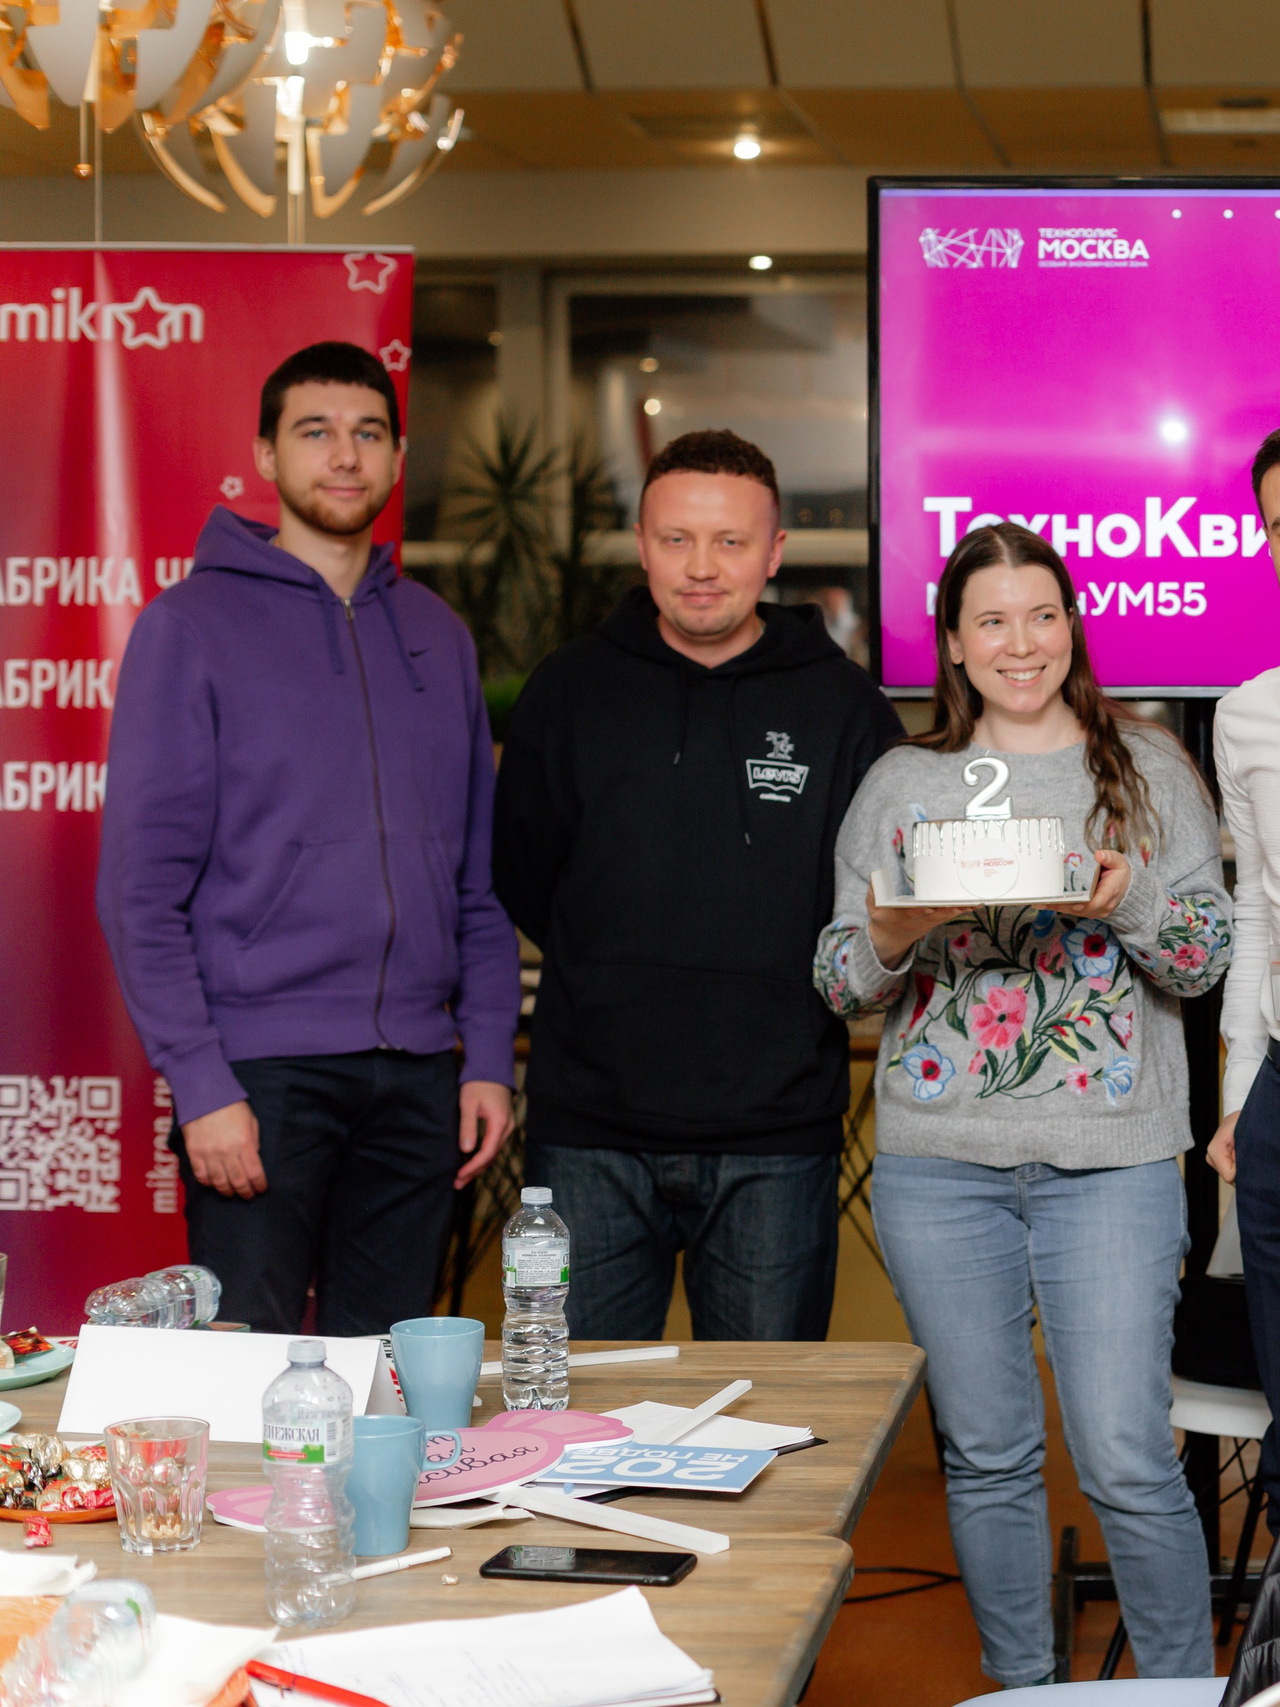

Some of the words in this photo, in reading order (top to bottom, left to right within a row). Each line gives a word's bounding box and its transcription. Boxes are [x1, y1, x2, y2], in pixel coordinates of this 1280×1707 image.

[1038, 239, 1150, 260] МОСКВА
[0, 556, 142, 607] БРИКА
[0, 658, 114, 709] БРИК
[0, 761, 108, 812] БРИК
[962, 756, 1012, 819] 2
[418, 1445, 539, 1486] сивая
[699, 1453, 749, 1463] НЕ
